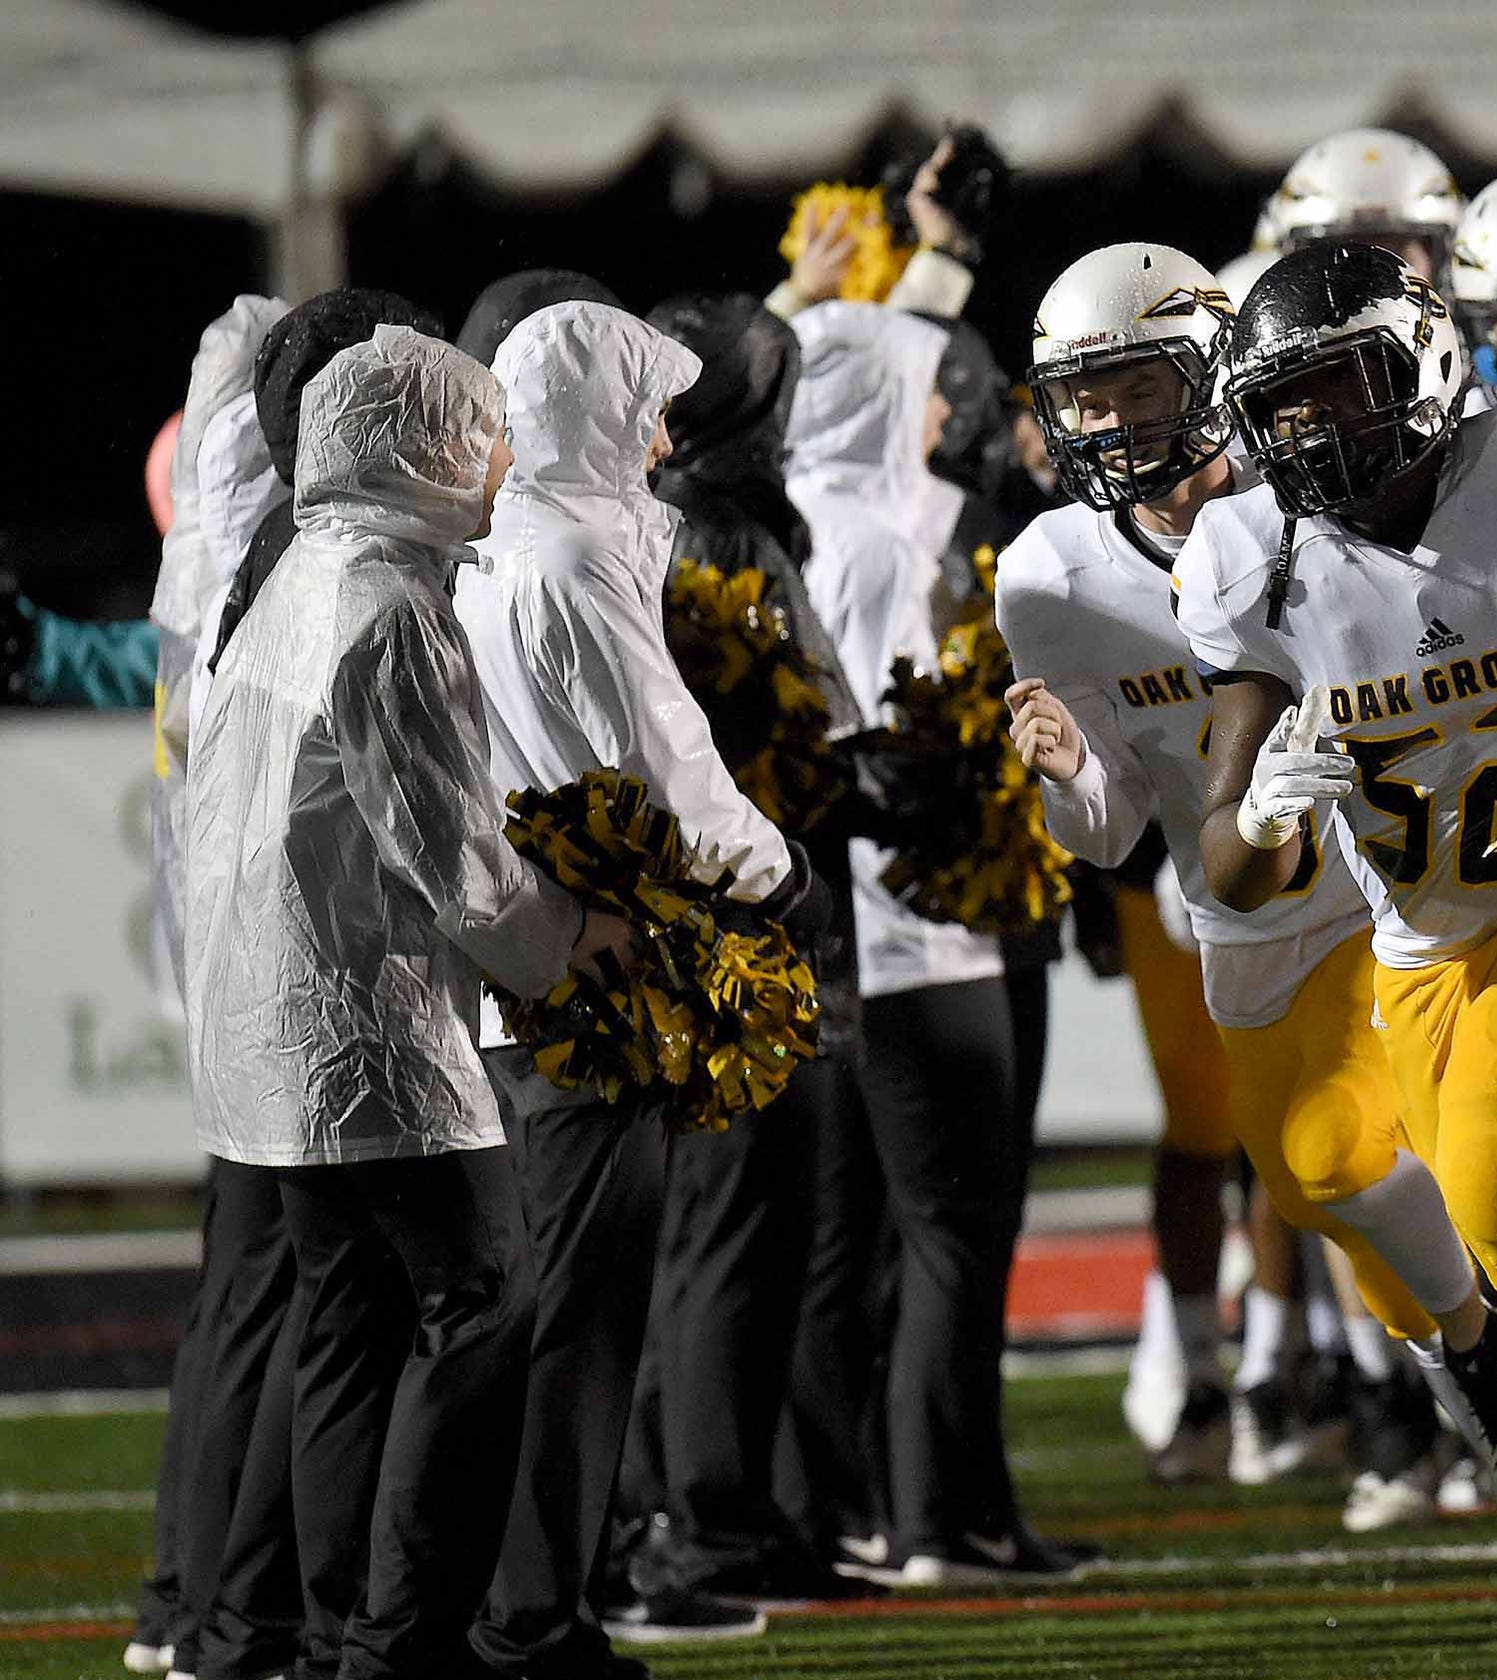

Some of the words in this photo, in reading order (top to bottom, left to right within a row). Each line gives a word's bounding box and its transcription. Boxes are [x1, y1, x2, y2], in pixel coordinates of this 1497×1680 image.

[1416, 633, 1465, 657] adidas
[1118, 664, 1197, 708] OAK
[1330, 674, 1416, 728] OAK
